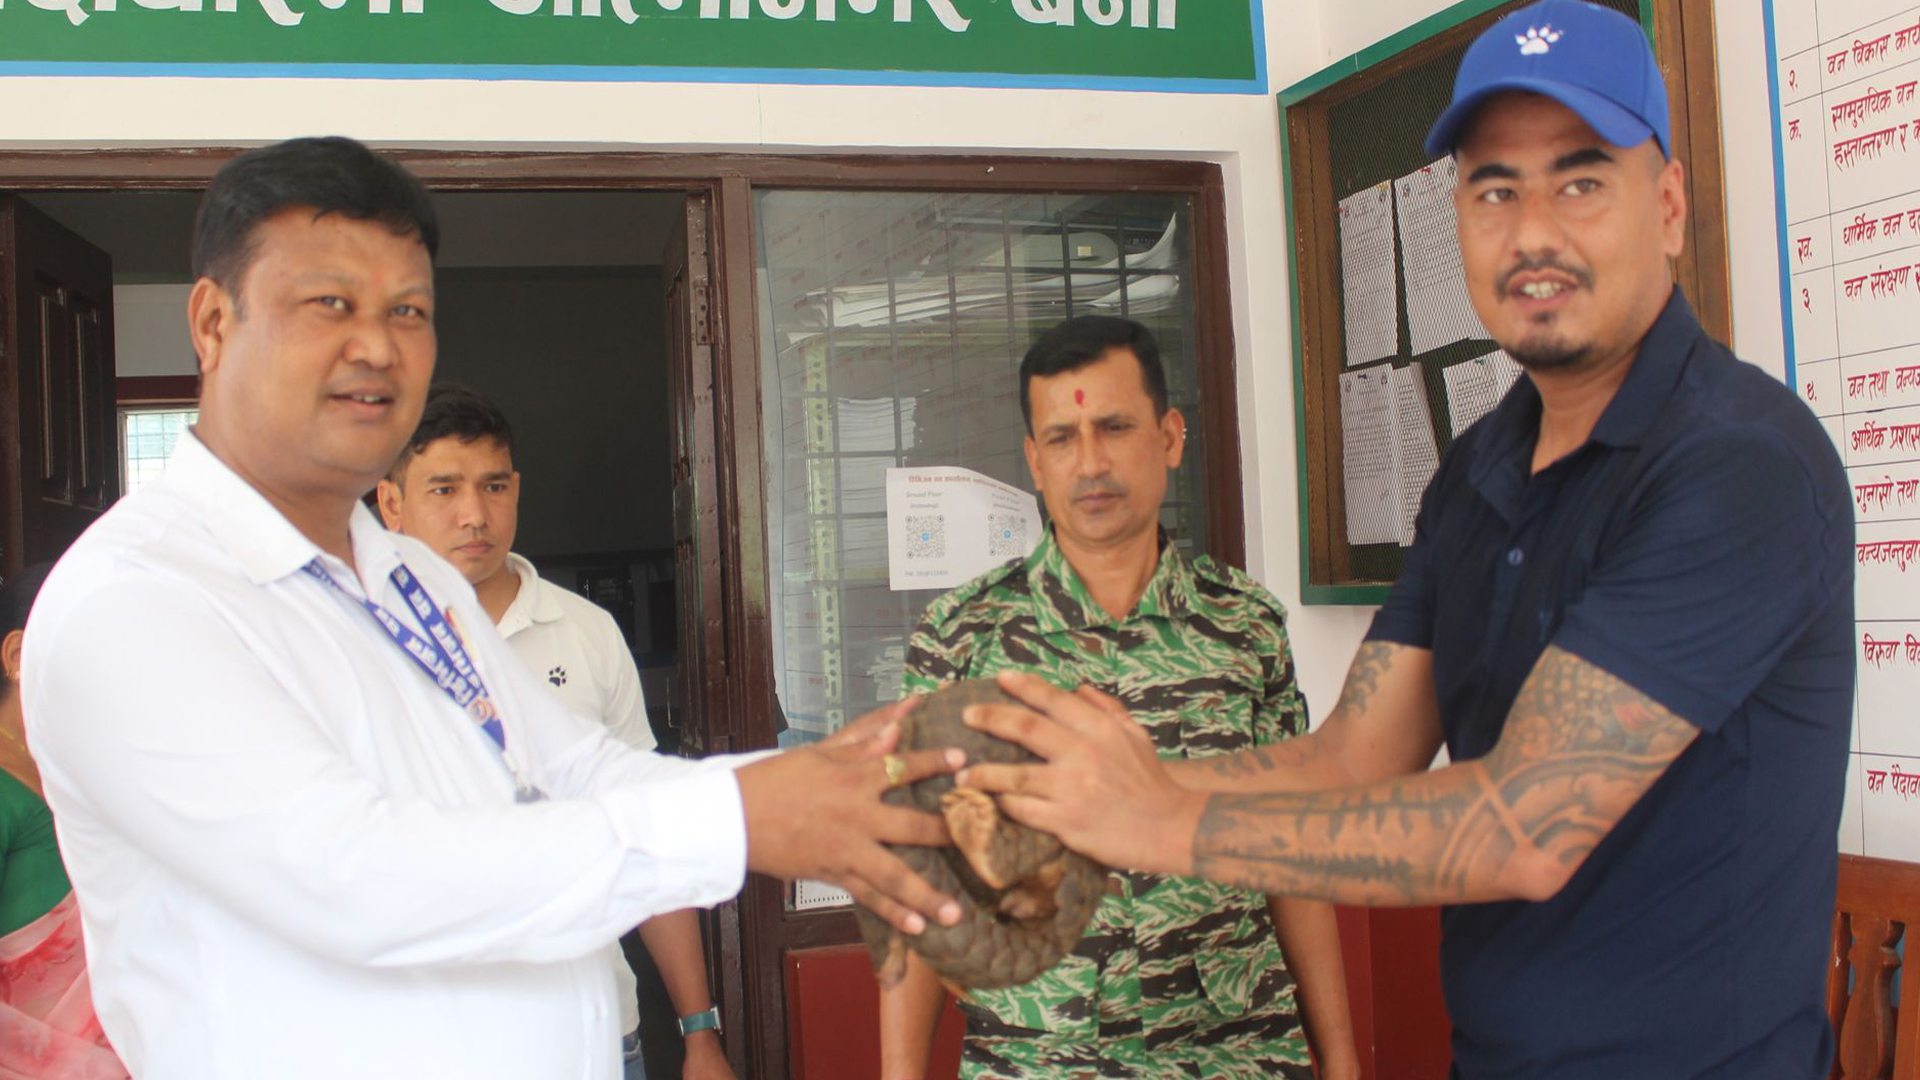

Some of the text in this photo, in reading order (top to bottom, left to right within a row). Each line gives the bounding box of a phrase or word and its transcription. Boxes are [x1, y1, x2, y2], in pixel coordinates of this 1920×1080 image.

[1827, 50, 1848, 75] वन
[1852, 35, 1891, 66] विकास
[1788, 70, 1798, 90] २.
[1831, 81, 1918, 131] सामुदायिक वन
[1788, 119, 1802, 141] क.
[1834, 127, 1897, 171] हस्तान्तरण
[1899, 124, 1908, 152] र
[1843, 212, 1878, 246] धार्मिक
[1882, 213, 1904, 239] वन
[1844, 276, 1868, 299] वन
[1870, 265, 1911, 299] संरक्षण
[1802, 288, 1812, 314] ३
[1848, 375, 1866, 398] वन
[1868, 370, 1890, 400] तथा
[1851, 421, 1888, 452] आर्थिक
[1855, 475, 1919, 513] गुनासो तथा
[1856, 540, 1920, 572] वन्यजन्तुबा
[1866, 764, 1920, 802] वन पैदाव
